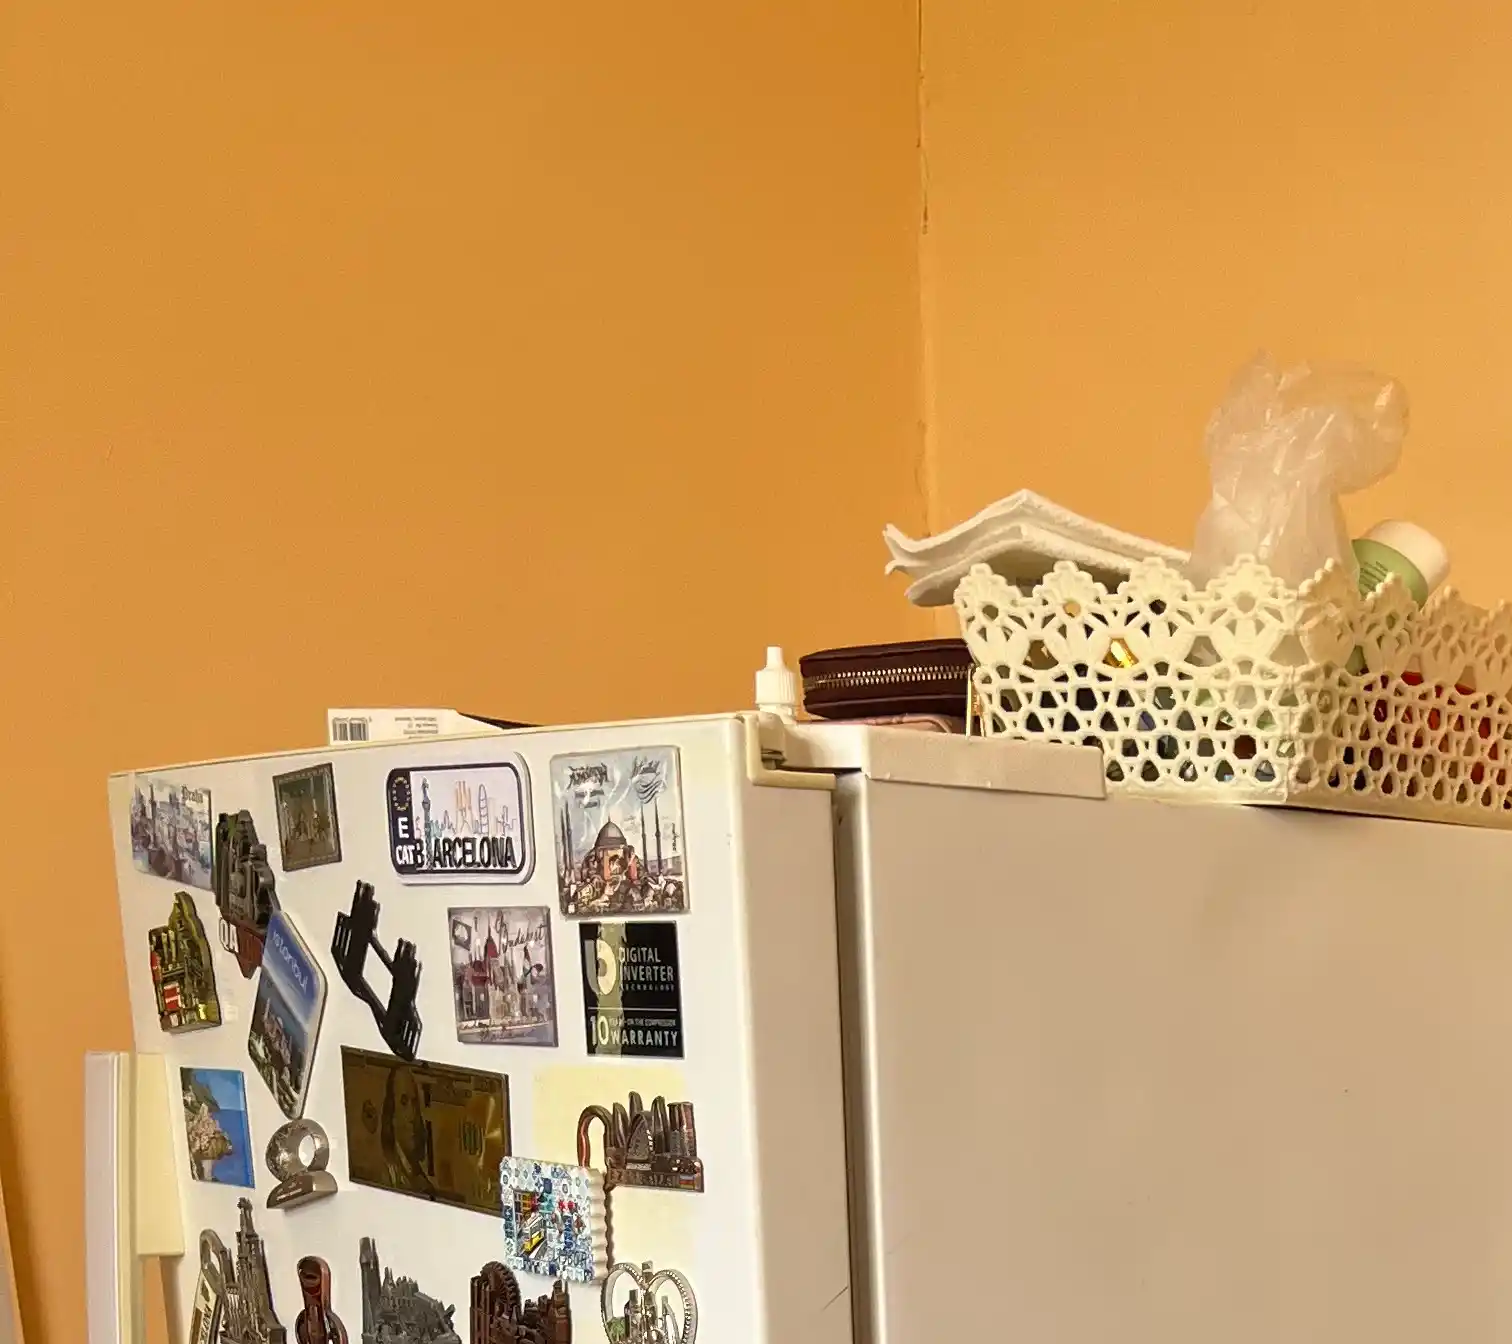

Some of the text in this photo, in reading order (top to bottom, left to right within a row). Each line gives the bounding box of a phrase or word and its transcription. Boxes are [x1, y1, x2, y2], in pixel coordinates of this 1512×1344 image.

[398, 816, 410, 839] E
[395, 844, 415, 866] CAT
[414, 836, 517, 869] BARCELONA
[618, 946, 662, 963] DIGITAL
[620, 964, 675, 982] INVERTER
[589, 1015, 610, 1046] 10
[610, 1029, 679, 1046] WARRANTY
